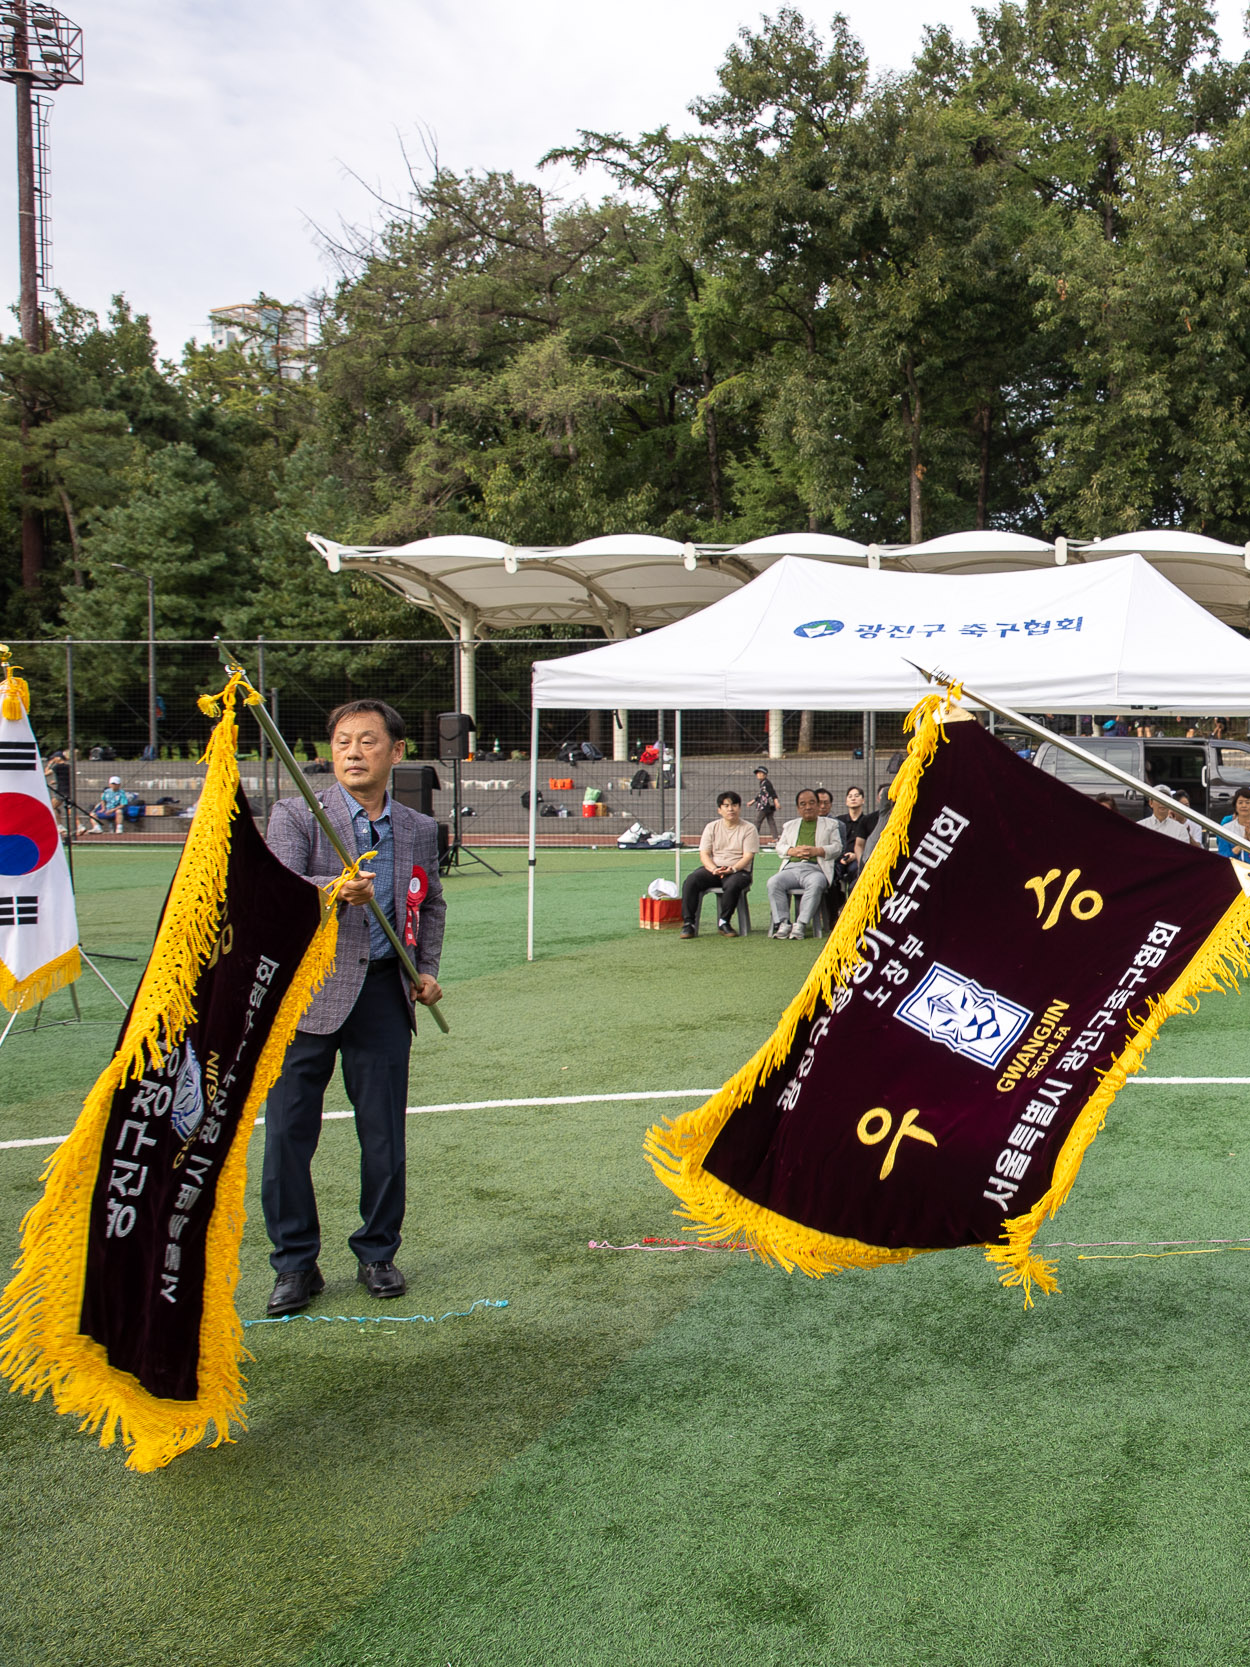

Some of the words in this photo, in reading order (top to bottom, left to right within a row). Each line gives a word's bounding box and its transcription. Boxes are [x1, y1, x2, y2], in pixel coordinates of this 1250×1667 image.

[854, 623, 946, 639] 광진구
[958, 616, 1083, 638] 축구협회
[880, 805, 971, 925] 축구대회
[983, 1078, 1074, 1213] 서울특별시
[1055, 921, 1182, 1072] 광진구축구협회
[996, 999, 1070, 1093] GWANGJIN
[1027, 1042, 1061, 1079] SEOUL
